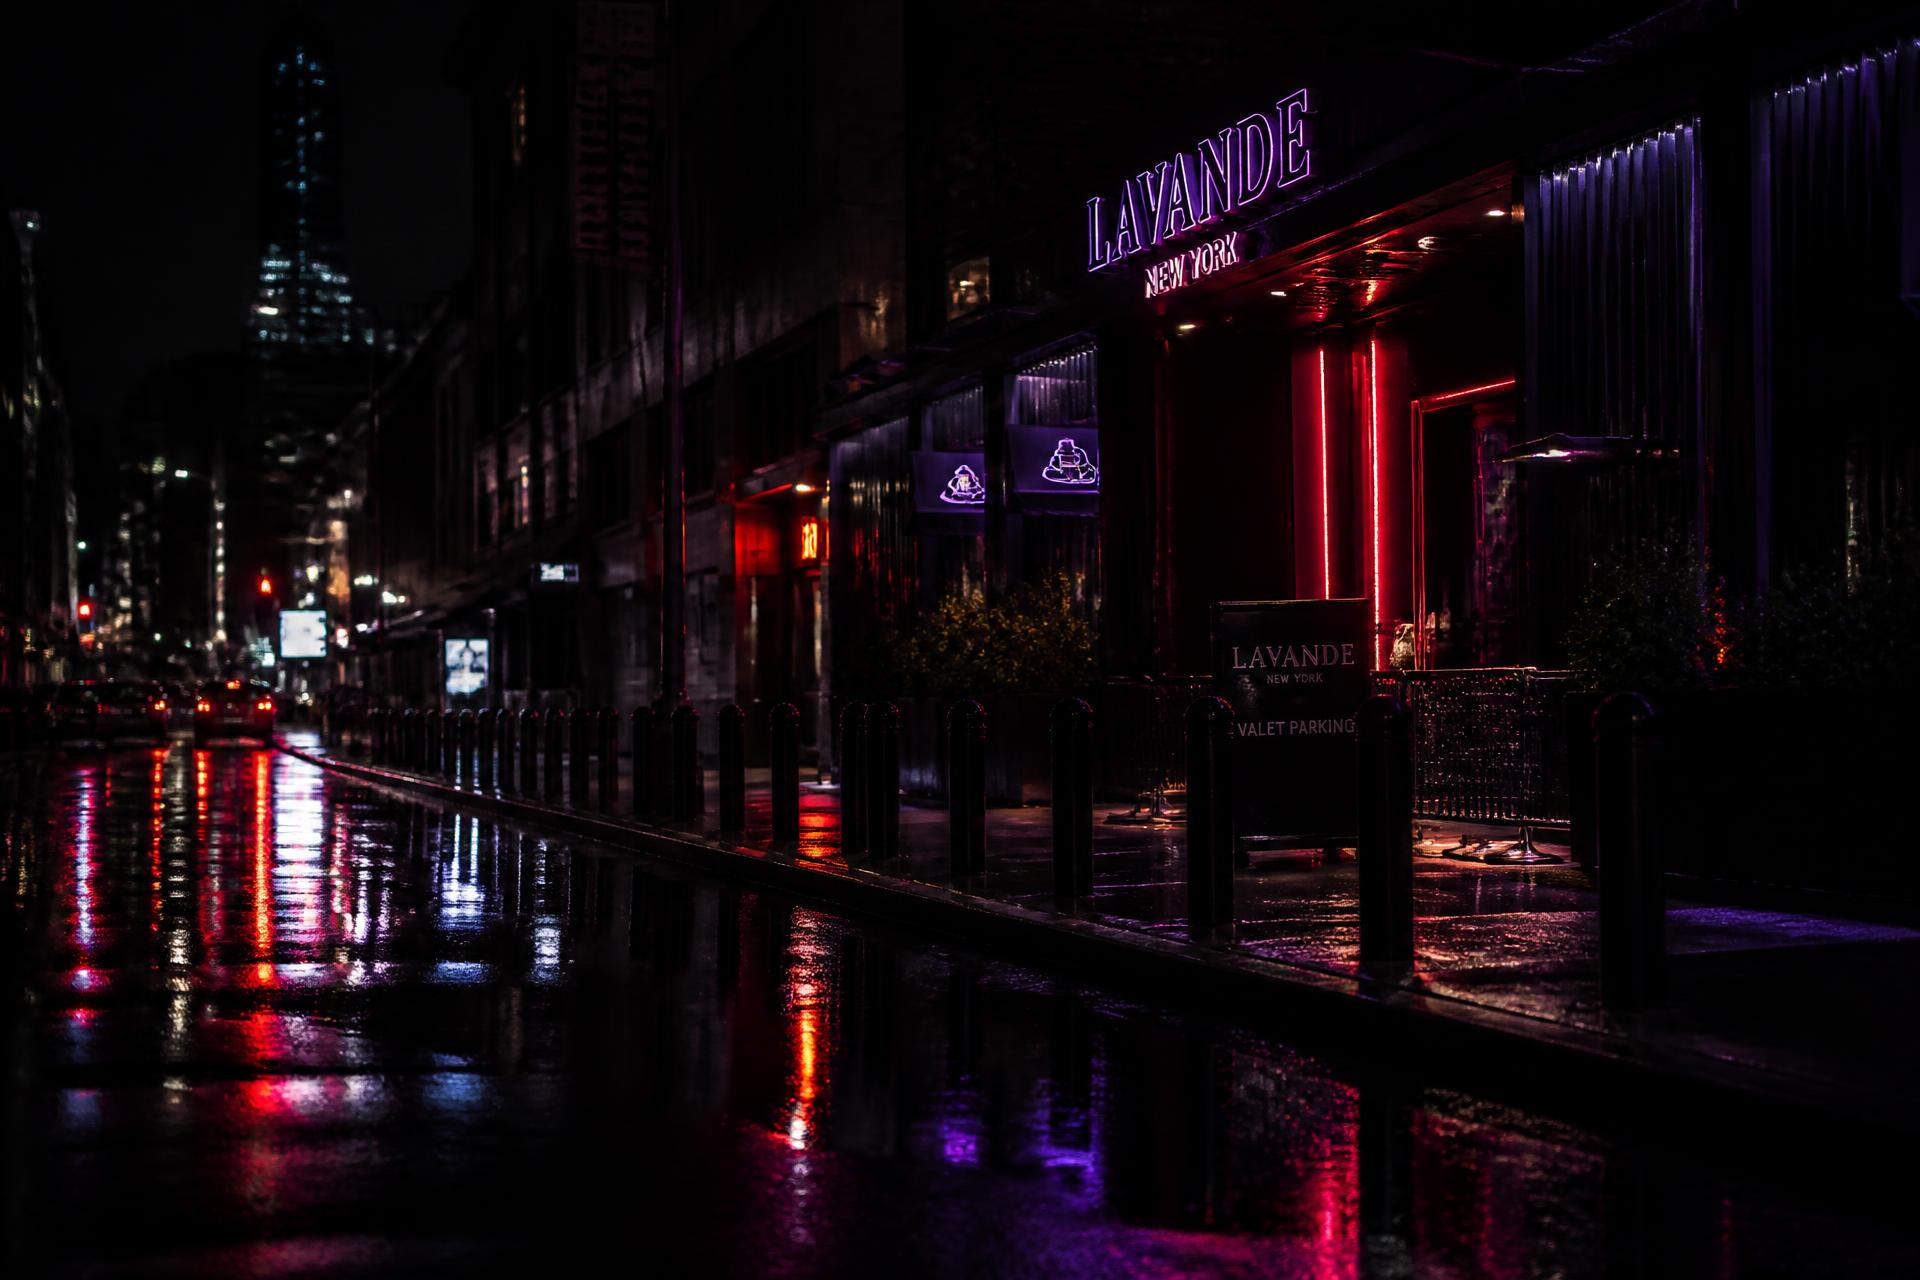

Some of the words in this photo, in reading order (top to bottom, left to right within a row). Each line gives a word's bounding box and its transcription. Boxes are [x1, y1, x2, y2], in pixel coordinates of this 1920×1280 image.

[1086, 87, 1311, 273] LAVANDE
[1143, 253, 1186, 299] NEW
[1188, 230, 1241, 281] YORK
[1231, 643, 1356, 669] LAVANDE
[1266, 674, 1290, 685] NEW
[1294, 672, 1325, 684] YORK
[1237, 720, 1286, 737] VALET
[1289, 718, 1356, 735] PARKING
